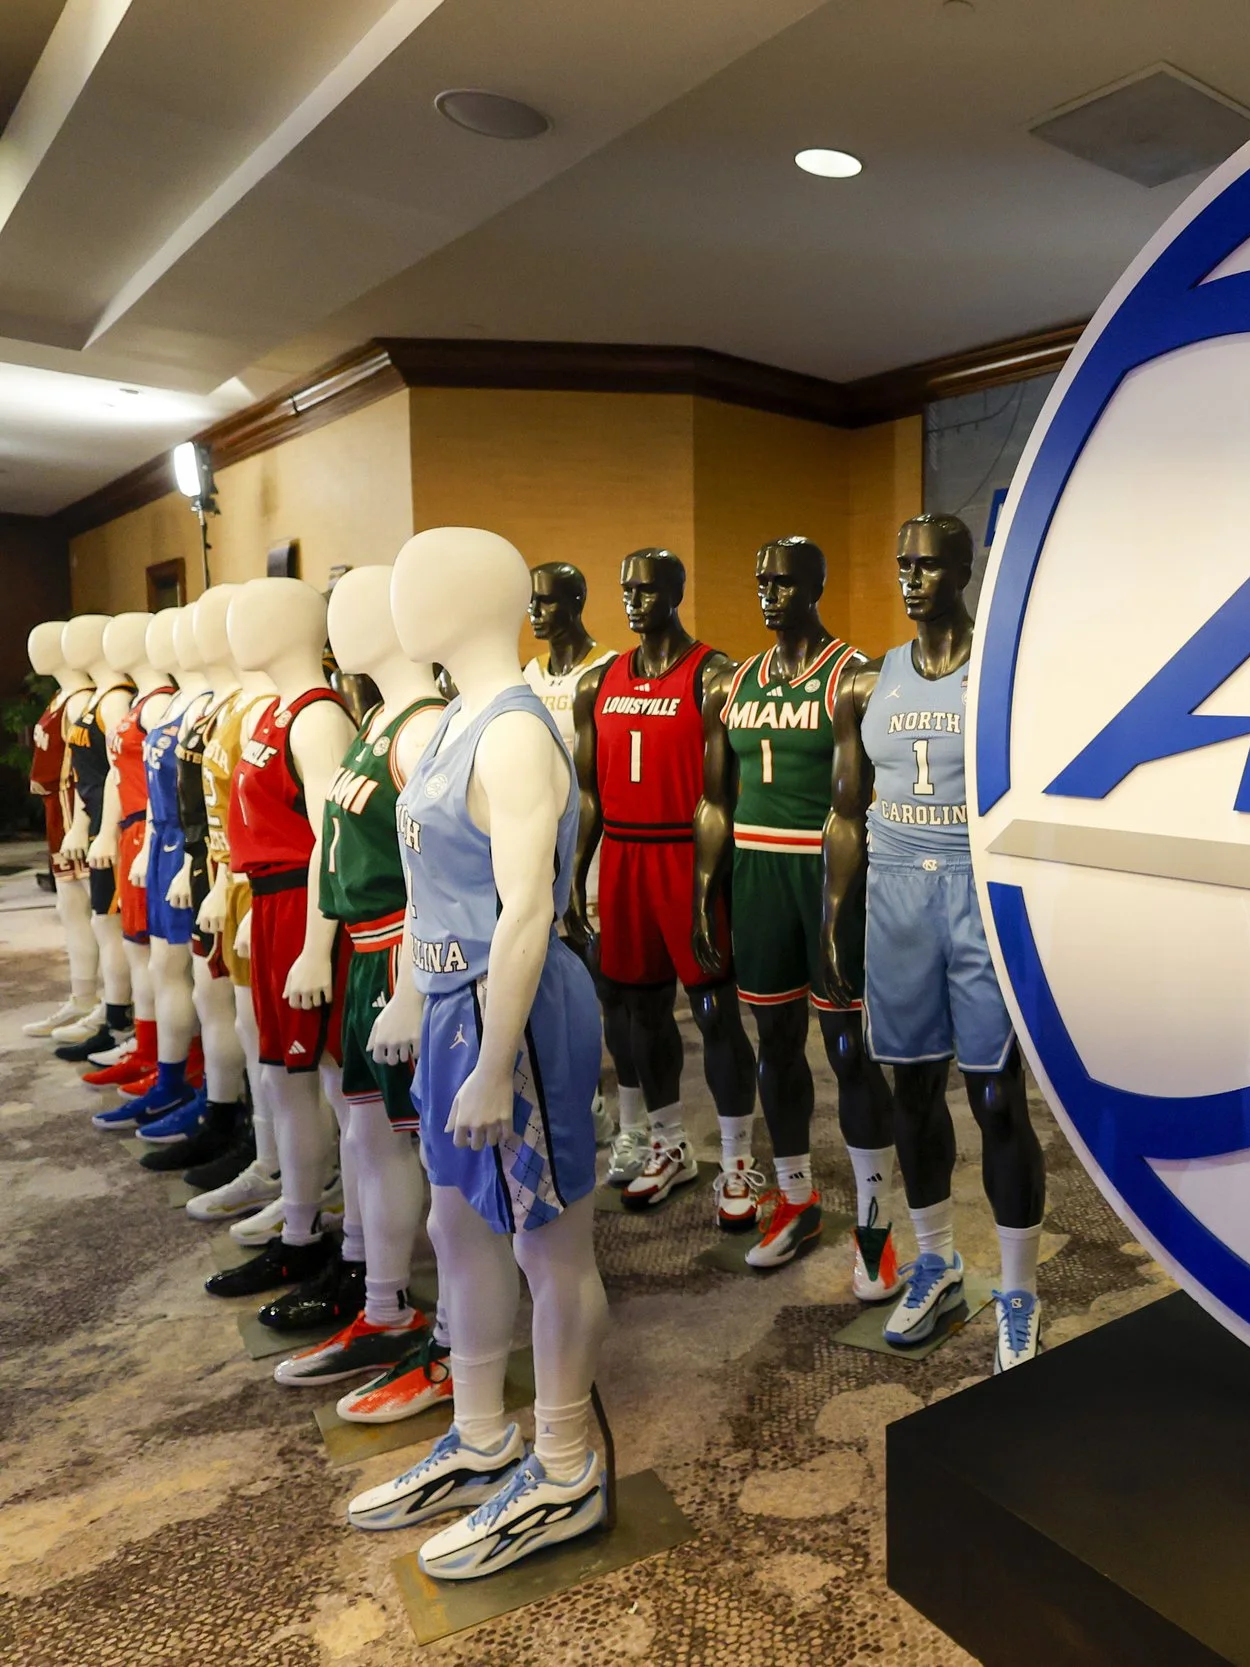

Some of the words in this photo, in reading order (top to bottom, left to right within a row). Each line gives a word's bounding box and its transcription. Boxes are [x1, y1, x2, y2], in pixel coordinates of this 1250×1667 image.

[602, 696, 681, 717] LOUISVILLE
[728, 700, 820, 730] MIAMI
[888, 711, 961, 735] NORTH
[629, 729, 643, 783] 1
[761, 738, 774, 784] 1
[912, 738, 935, 796] 1
[881, 800, 968, 826] CAROLIN
